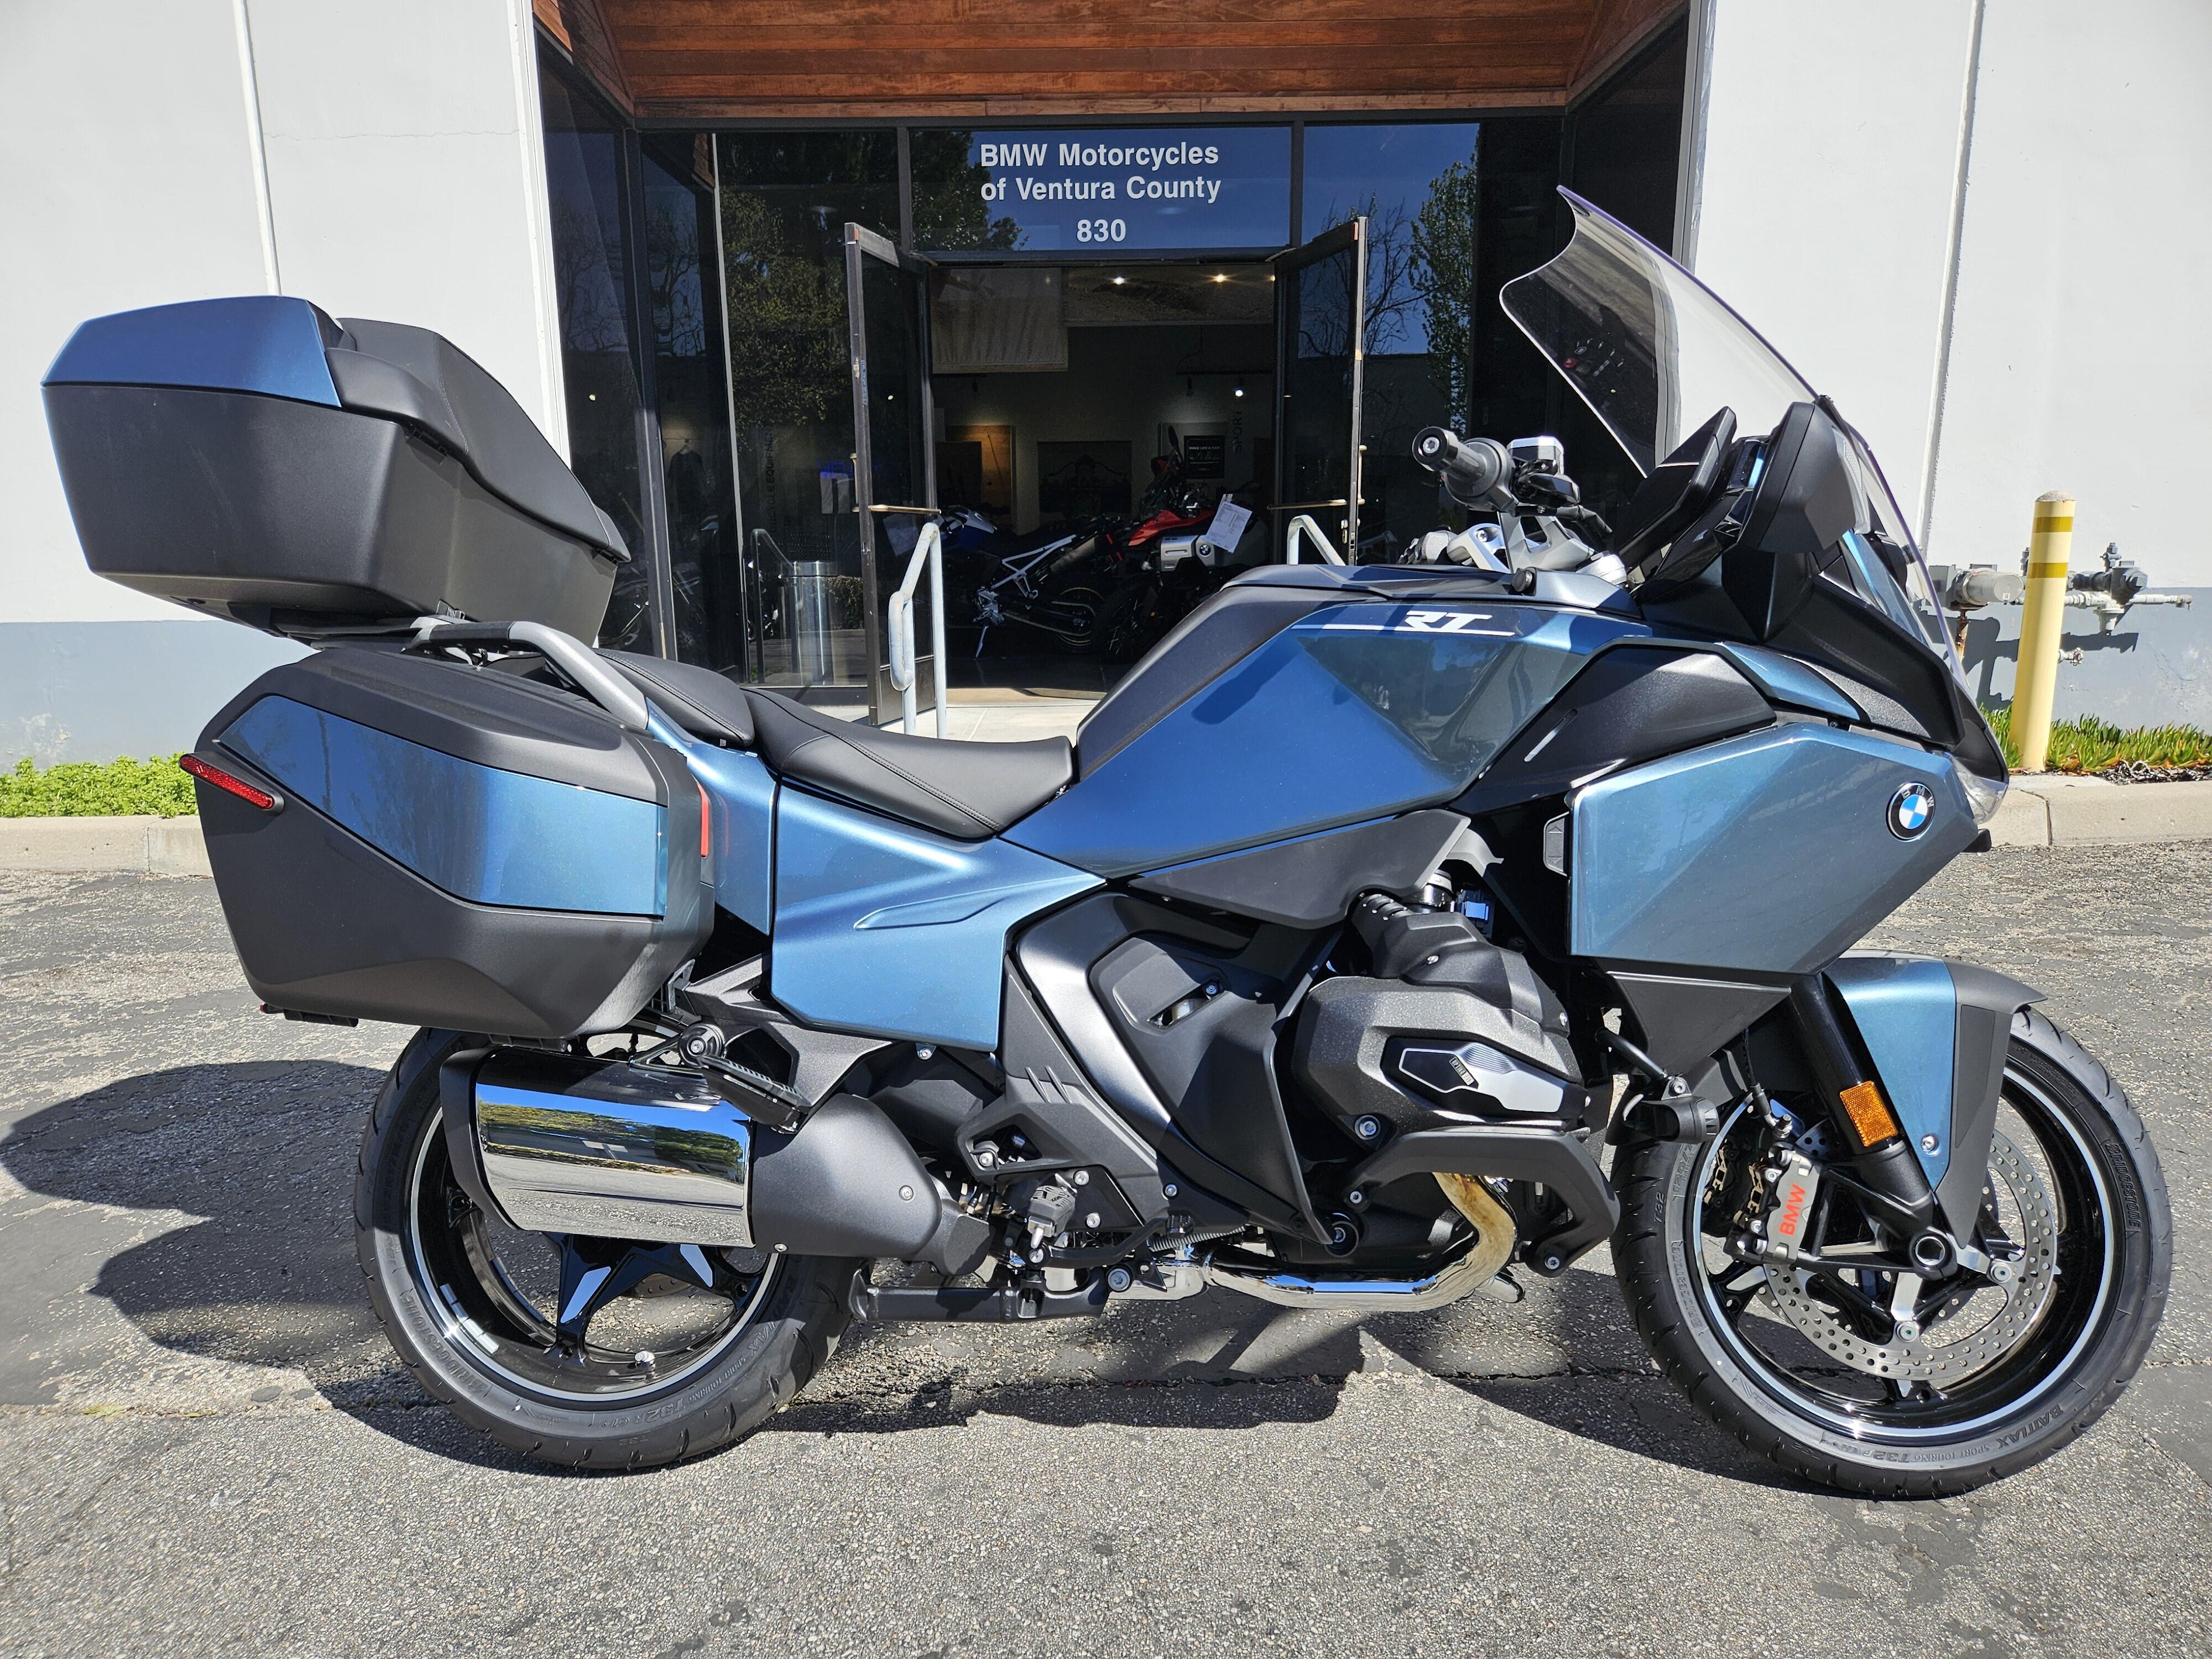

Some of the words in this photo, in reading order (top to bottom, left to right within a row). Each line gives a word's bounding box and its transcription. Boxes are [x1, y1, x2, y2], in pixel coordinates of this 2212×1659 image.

[981, 144, 1047, 166] BMW
[1060, 142, 1218, 170] Motorcycles
[982, 178, 1006, 200] of
[1016, 178, 1115, 200] Ventura
[1127, 176, 1221, 203] County
[1077, 219, 1125, 242] 830
[1405, 610, 1493, 632] RT
[1900, 785, 1935, 807] BMW
[2105, 1143, 2142, 1228] BRIDGESTONE
[1778, 1183, 1806, 1236] BMW
[1671, 1246, 1703, 1328] BRIDGESTONE
[398, 1293, 489, 1397] BRIDGESTONE
[1995, 1404, 2064, 1449] BATTLAX
[1914, 1449, 1957, 1462] TOURING
[1958, 1443, 1990, 1460] SPORT
